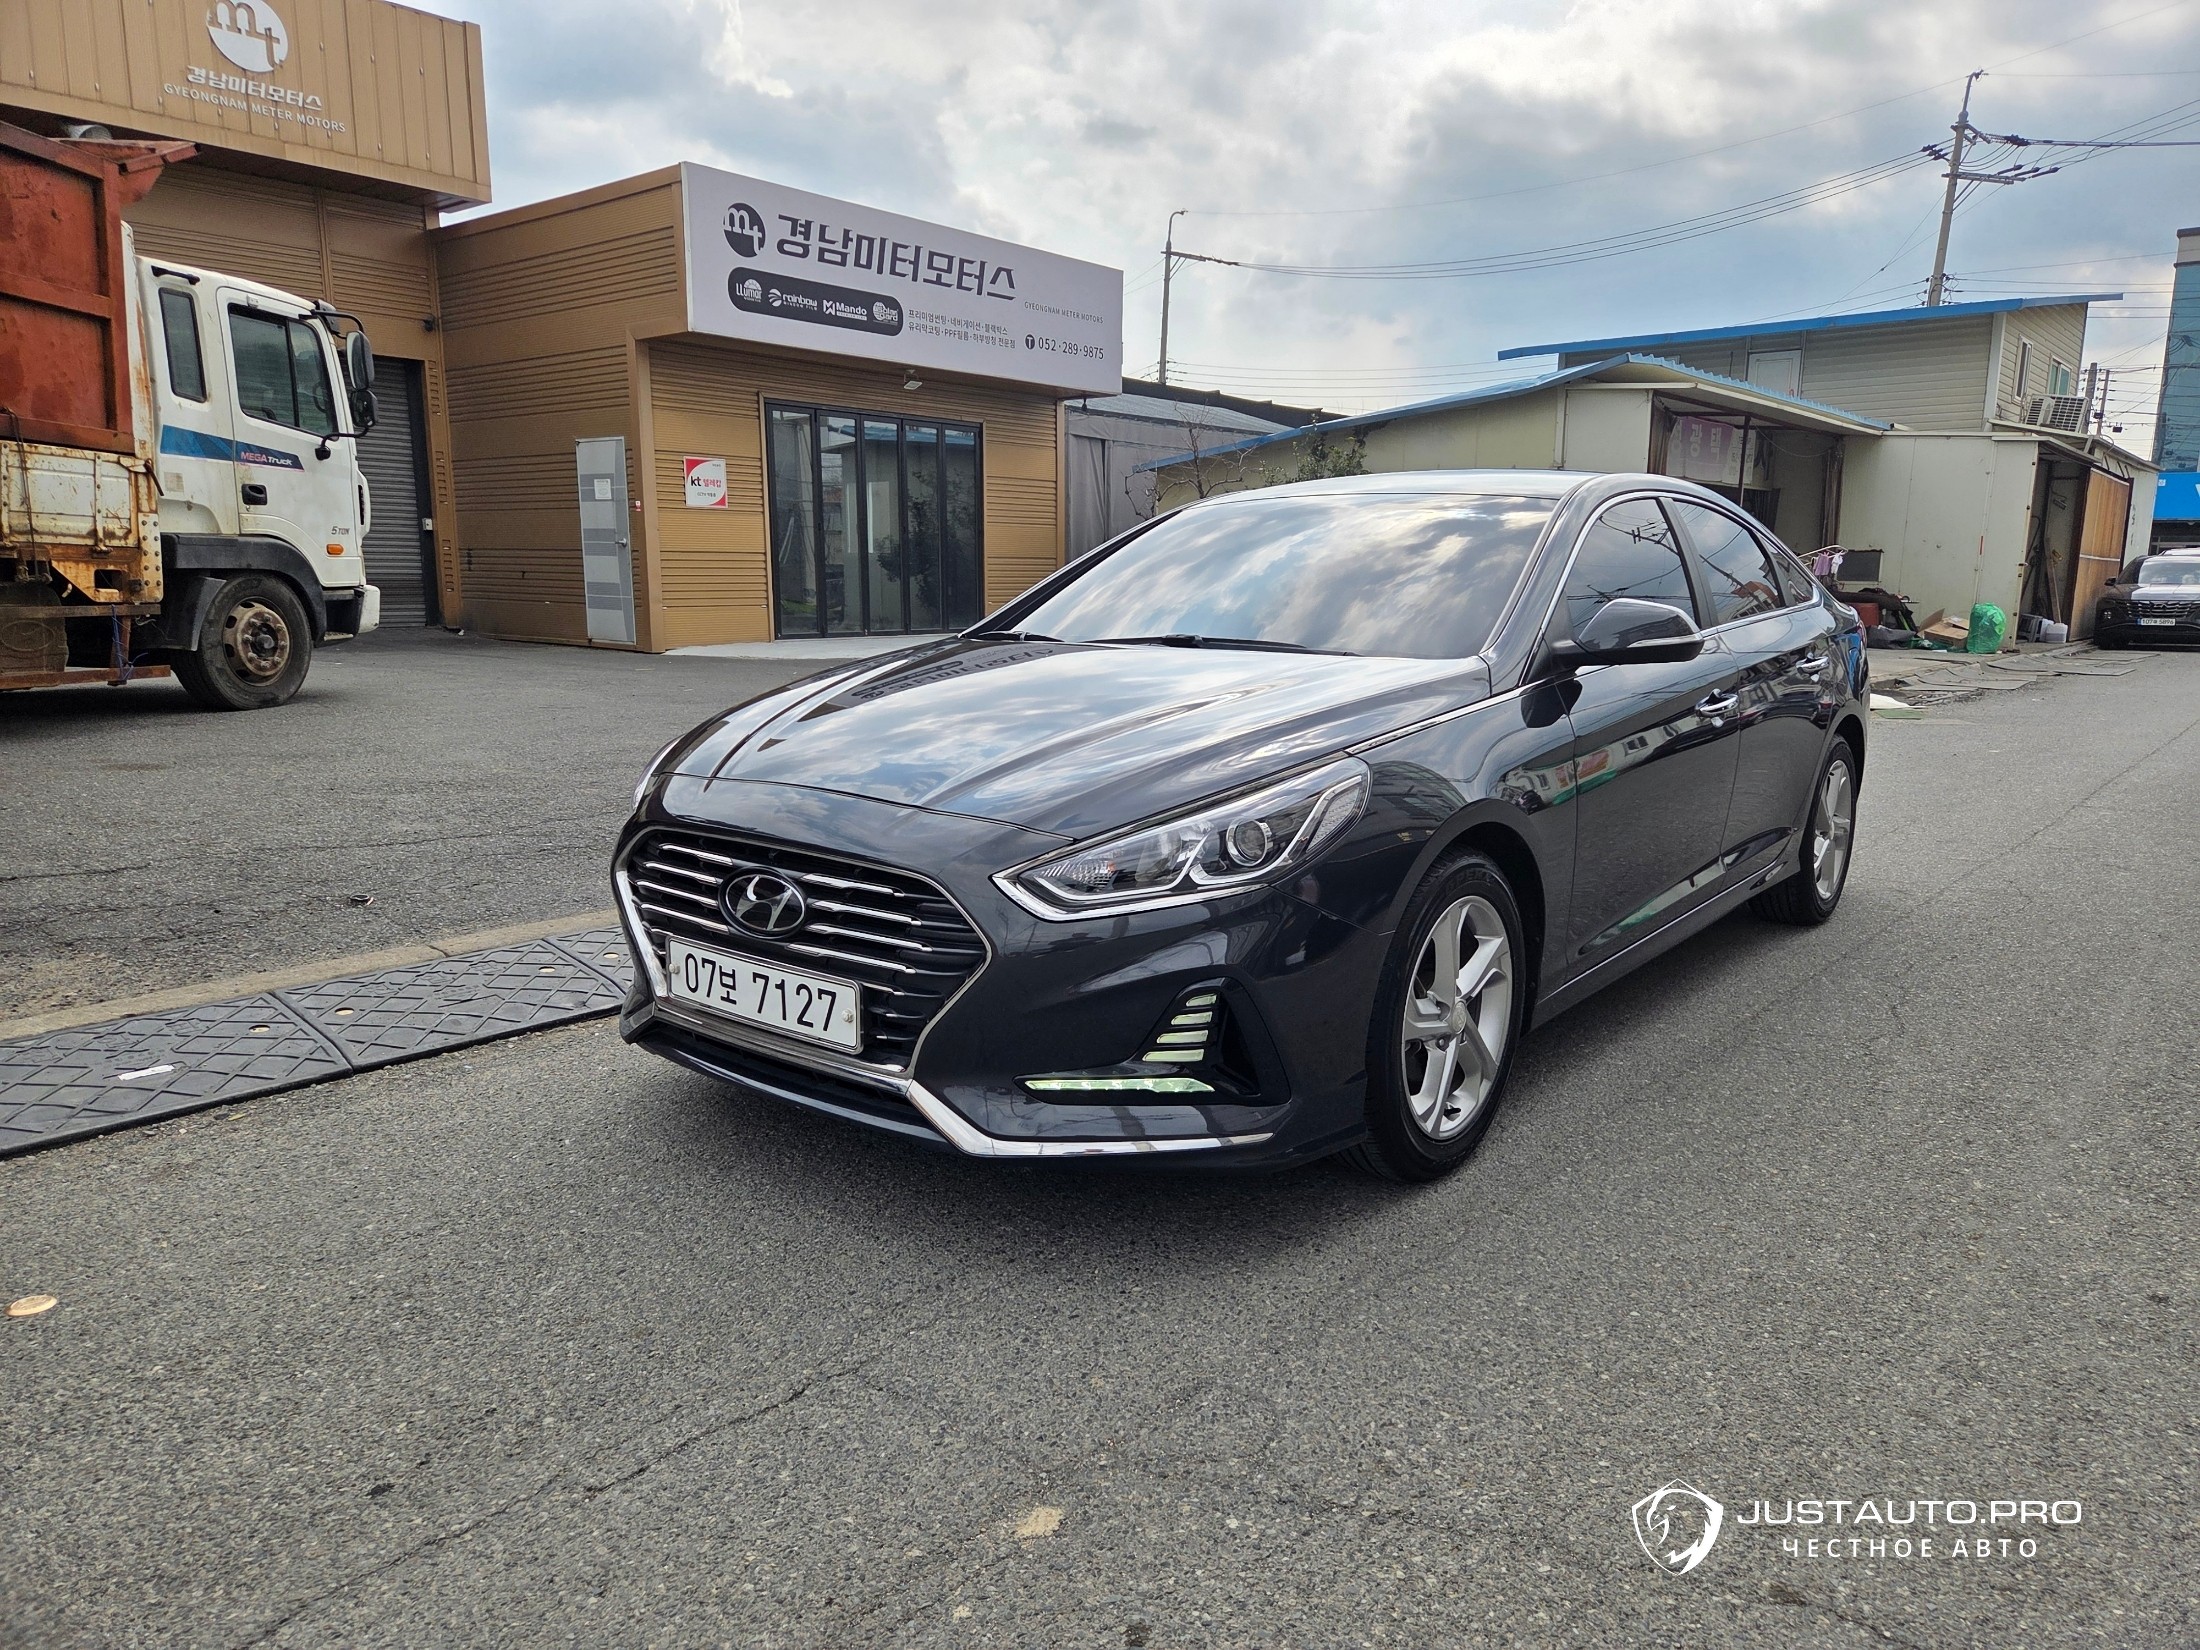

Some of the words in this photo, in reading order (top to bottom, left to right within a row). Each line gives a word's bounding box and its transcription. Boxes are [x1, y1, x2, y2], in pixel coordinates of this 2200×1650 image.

[187, 65, 323, 111] 경남미터모터스
[163, 83, 248, 112] GYEONGNAM
[251, 101, 293, 121] METER
[296, 111, 347, 133] MOTORS
[776, 213, 1017, 301] 경남미터모터스
[783, 293, 818, 307] rainbow
[836, 302, 868, 316] Mando
[1024, 301, 1060, 315] GYEONGNAM
[1062, 308, 1080, 319] METER
[1081, 312, 1104, 324] MOTORS
[241, 451, 267, 463] MEGA
[268, 456, 293, 466] Truck
[690, 475, 702, 487] kt
[684, 952, 737, 1006] 07보
[752, 971, 837, 1032] 7127
